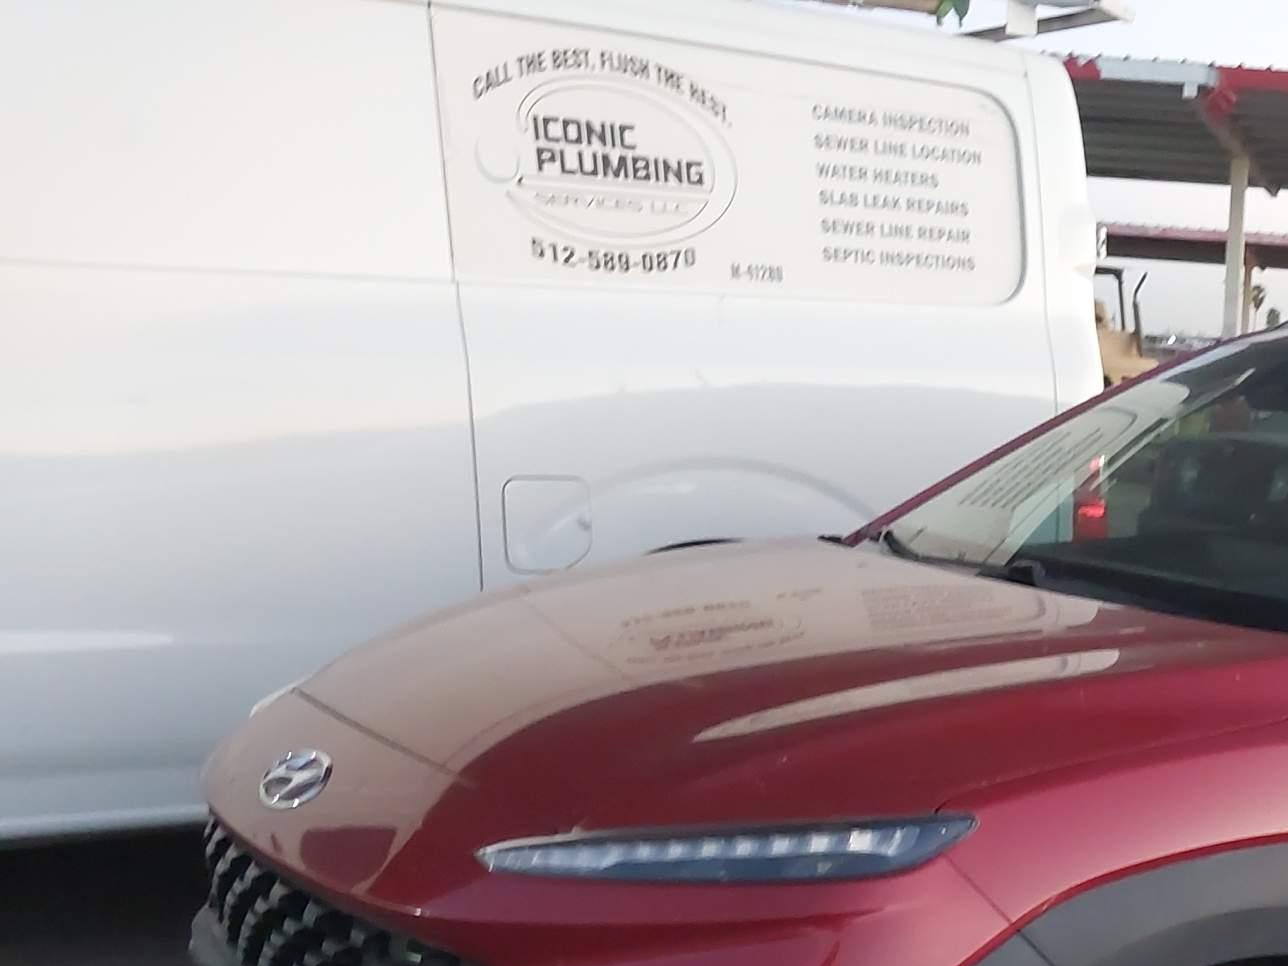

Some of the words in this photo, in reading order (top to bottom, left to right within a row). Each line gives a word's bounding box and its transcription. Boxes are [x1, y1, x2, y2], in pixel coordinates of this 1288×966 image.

[472, 64, 513, 100] CALL
[516, 52, 548, 78] THE
[550, 48, 595, 73] BEST,
[599, 50, 651, 81] FLUSH
[653, 63, 685, 93] THE
[532, 114, 637, 151] ICONIC
[811, 104, 878, 126] CAMERA
[882, 111, 971, 137] INSPECTION
[535, 146, 706, 186] PLUMBING
[813, 133, 870, 151] SEWER
[873, 140, 907, 159] LINE
[912, 144, 982, 166] LOCATION
[815, 162, 869, 182] WATER
[872, 168, 940, 189] HEATERS
[818, 189, 860, 208] SLAB
[863, 193, 902, 211] LEAK
[905, 199, 970, 217] REPAIRS
[820, 217, 876, 237] SEWER
[880, 222, 915, 240] LINE
[918, 225, 972, 244] REPAIR
[531, 237, 697, 273] 512-589-0870
[822, 246, 877, 266] SEPTIC
[880, 251, 976, 273] INSPECTIONS
